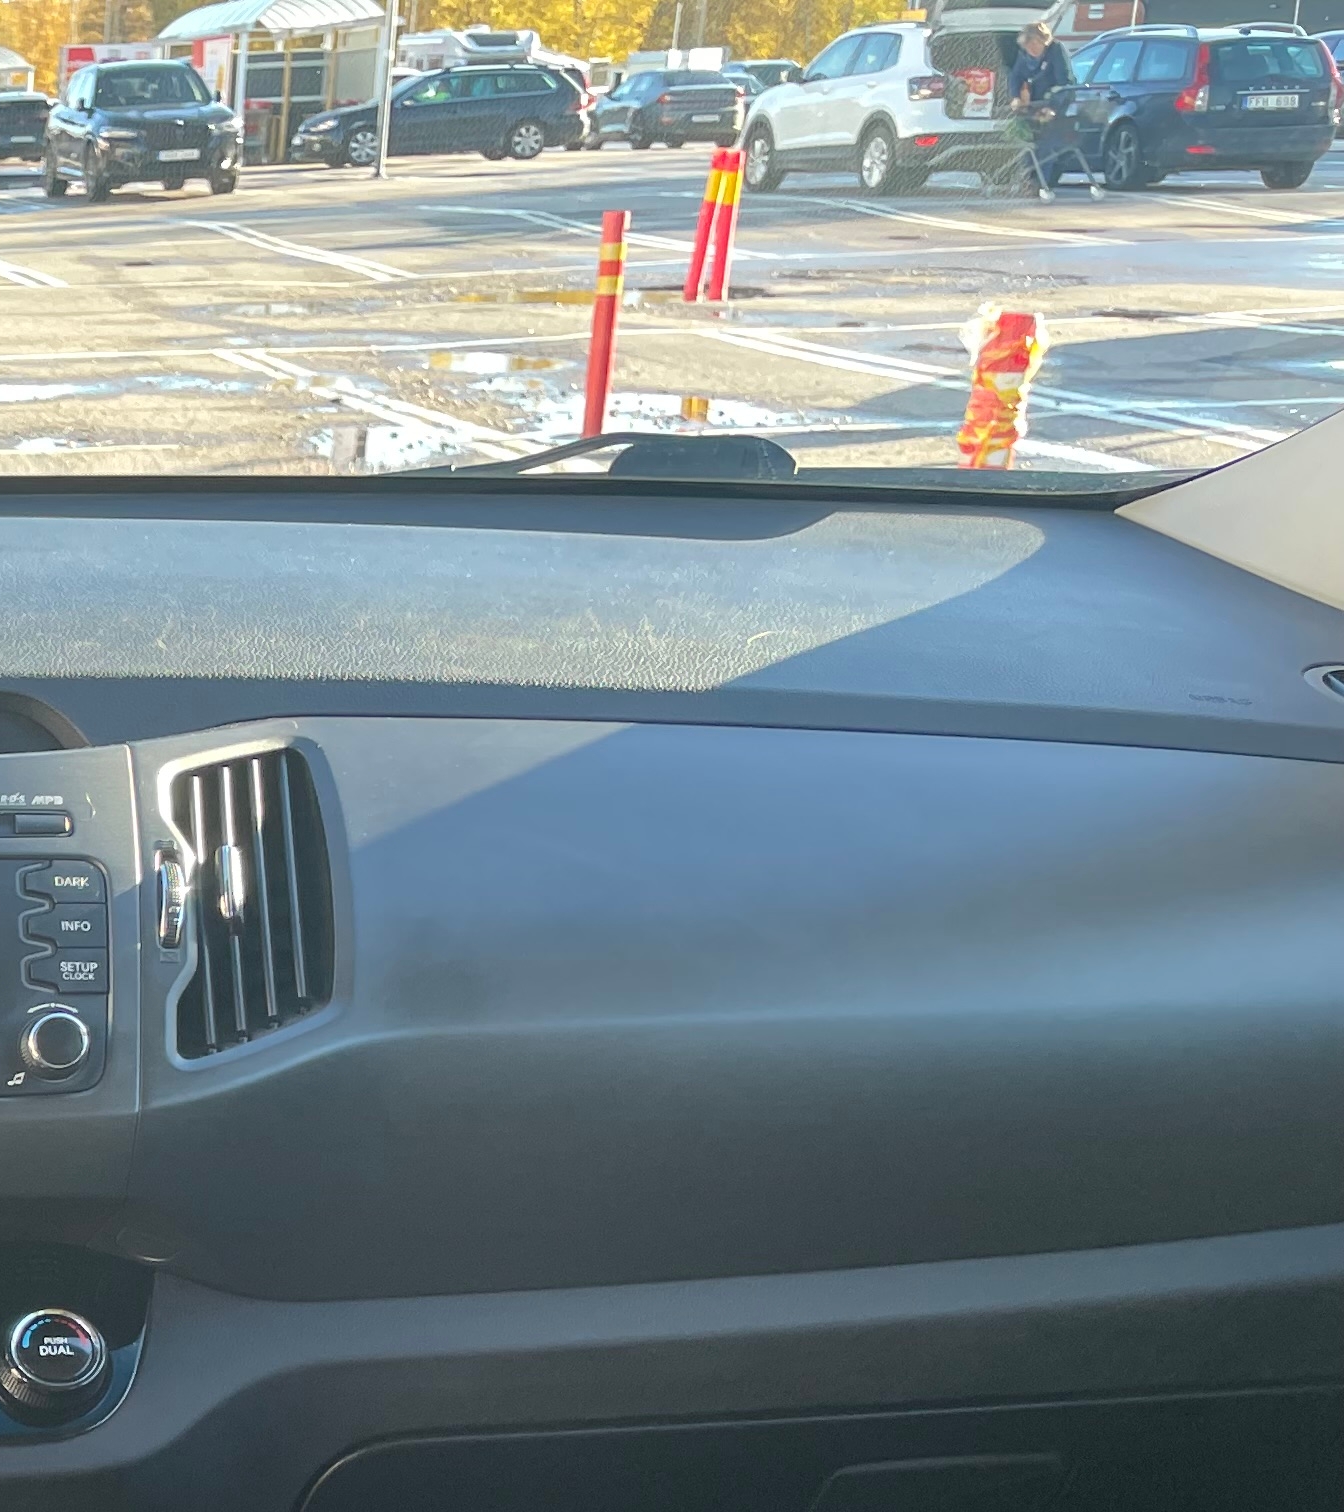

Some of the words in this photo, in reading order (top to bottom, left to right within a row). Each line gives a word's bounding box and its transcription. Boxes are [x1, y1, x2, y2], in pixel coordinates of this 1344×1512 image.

[54, 876, 89, 887] DARK
[61, 920, 91, 932] INFO
[60, 961, 98, 972] SETUP
[62, 972, 95, 981] CLOCK
[43, 1336, 68, 1345] PUSH
[39, 1345, 75, 1357] DUAL
